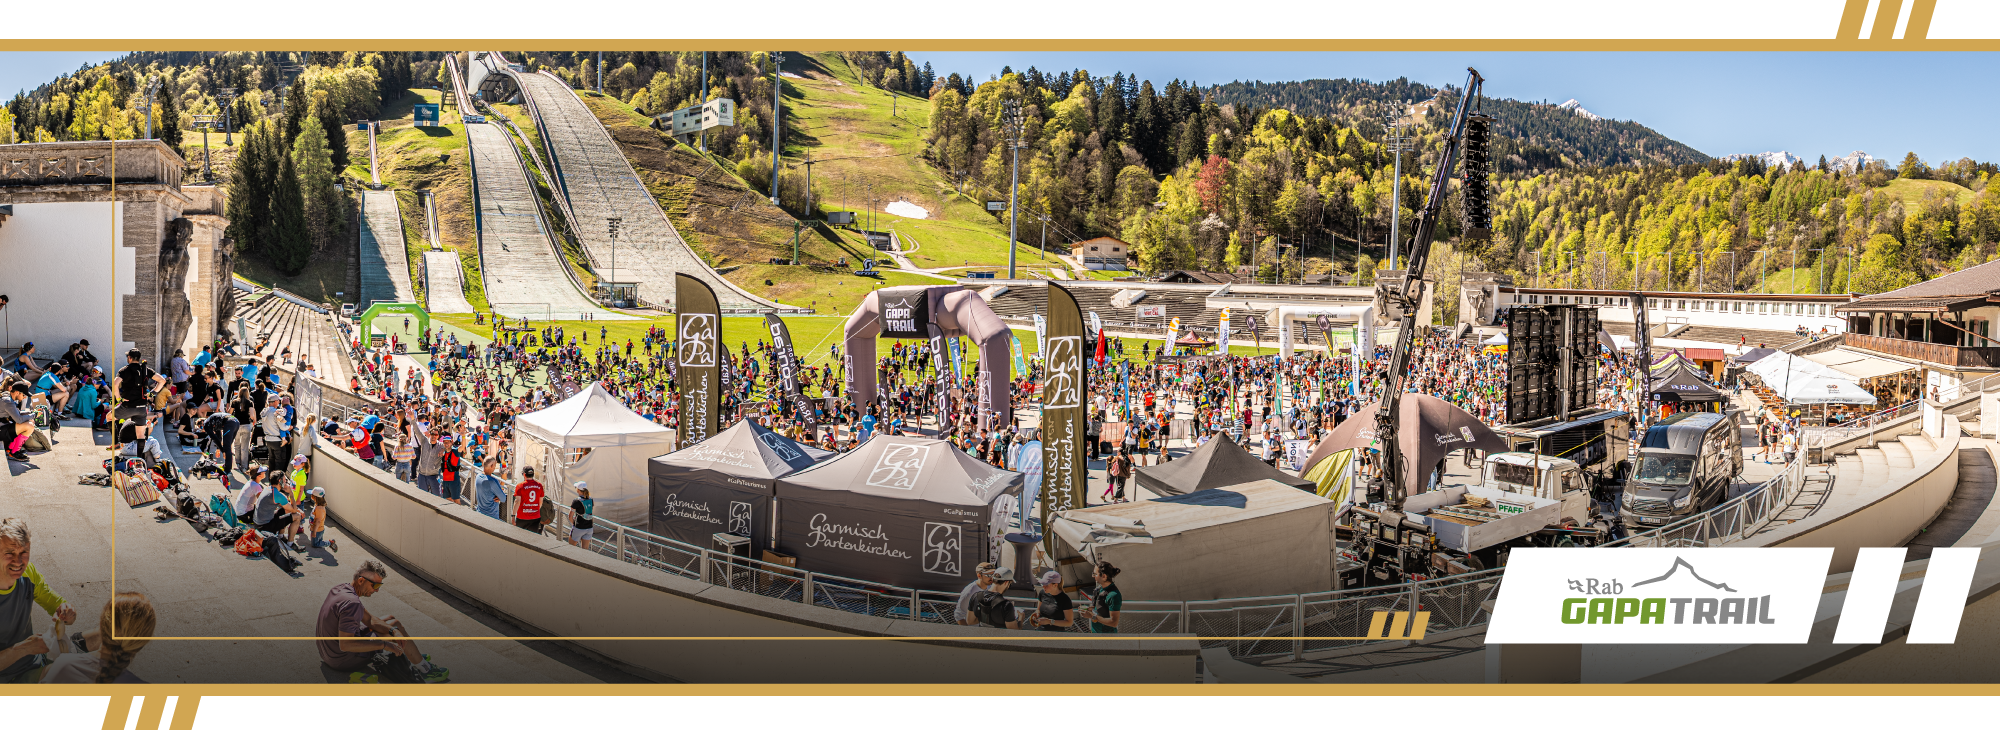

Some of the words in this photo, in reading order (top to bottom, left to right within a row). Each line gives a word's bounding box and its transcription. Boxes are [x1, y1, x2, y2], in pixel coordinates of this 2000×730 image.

[885, 308, 911, 319] GAPA
[886, 318, 917, 332] TRAIL
[1044, 437, 1059, 512] armisch
[528, 490, 537, 503] 9
[666, 493, 711, 513] Garmisch
[662, 505, 723, 525] Partenkirchen
[809, 512, 890, 541] Garmisch
[805, 530, 912, 559] Partenkirchen
